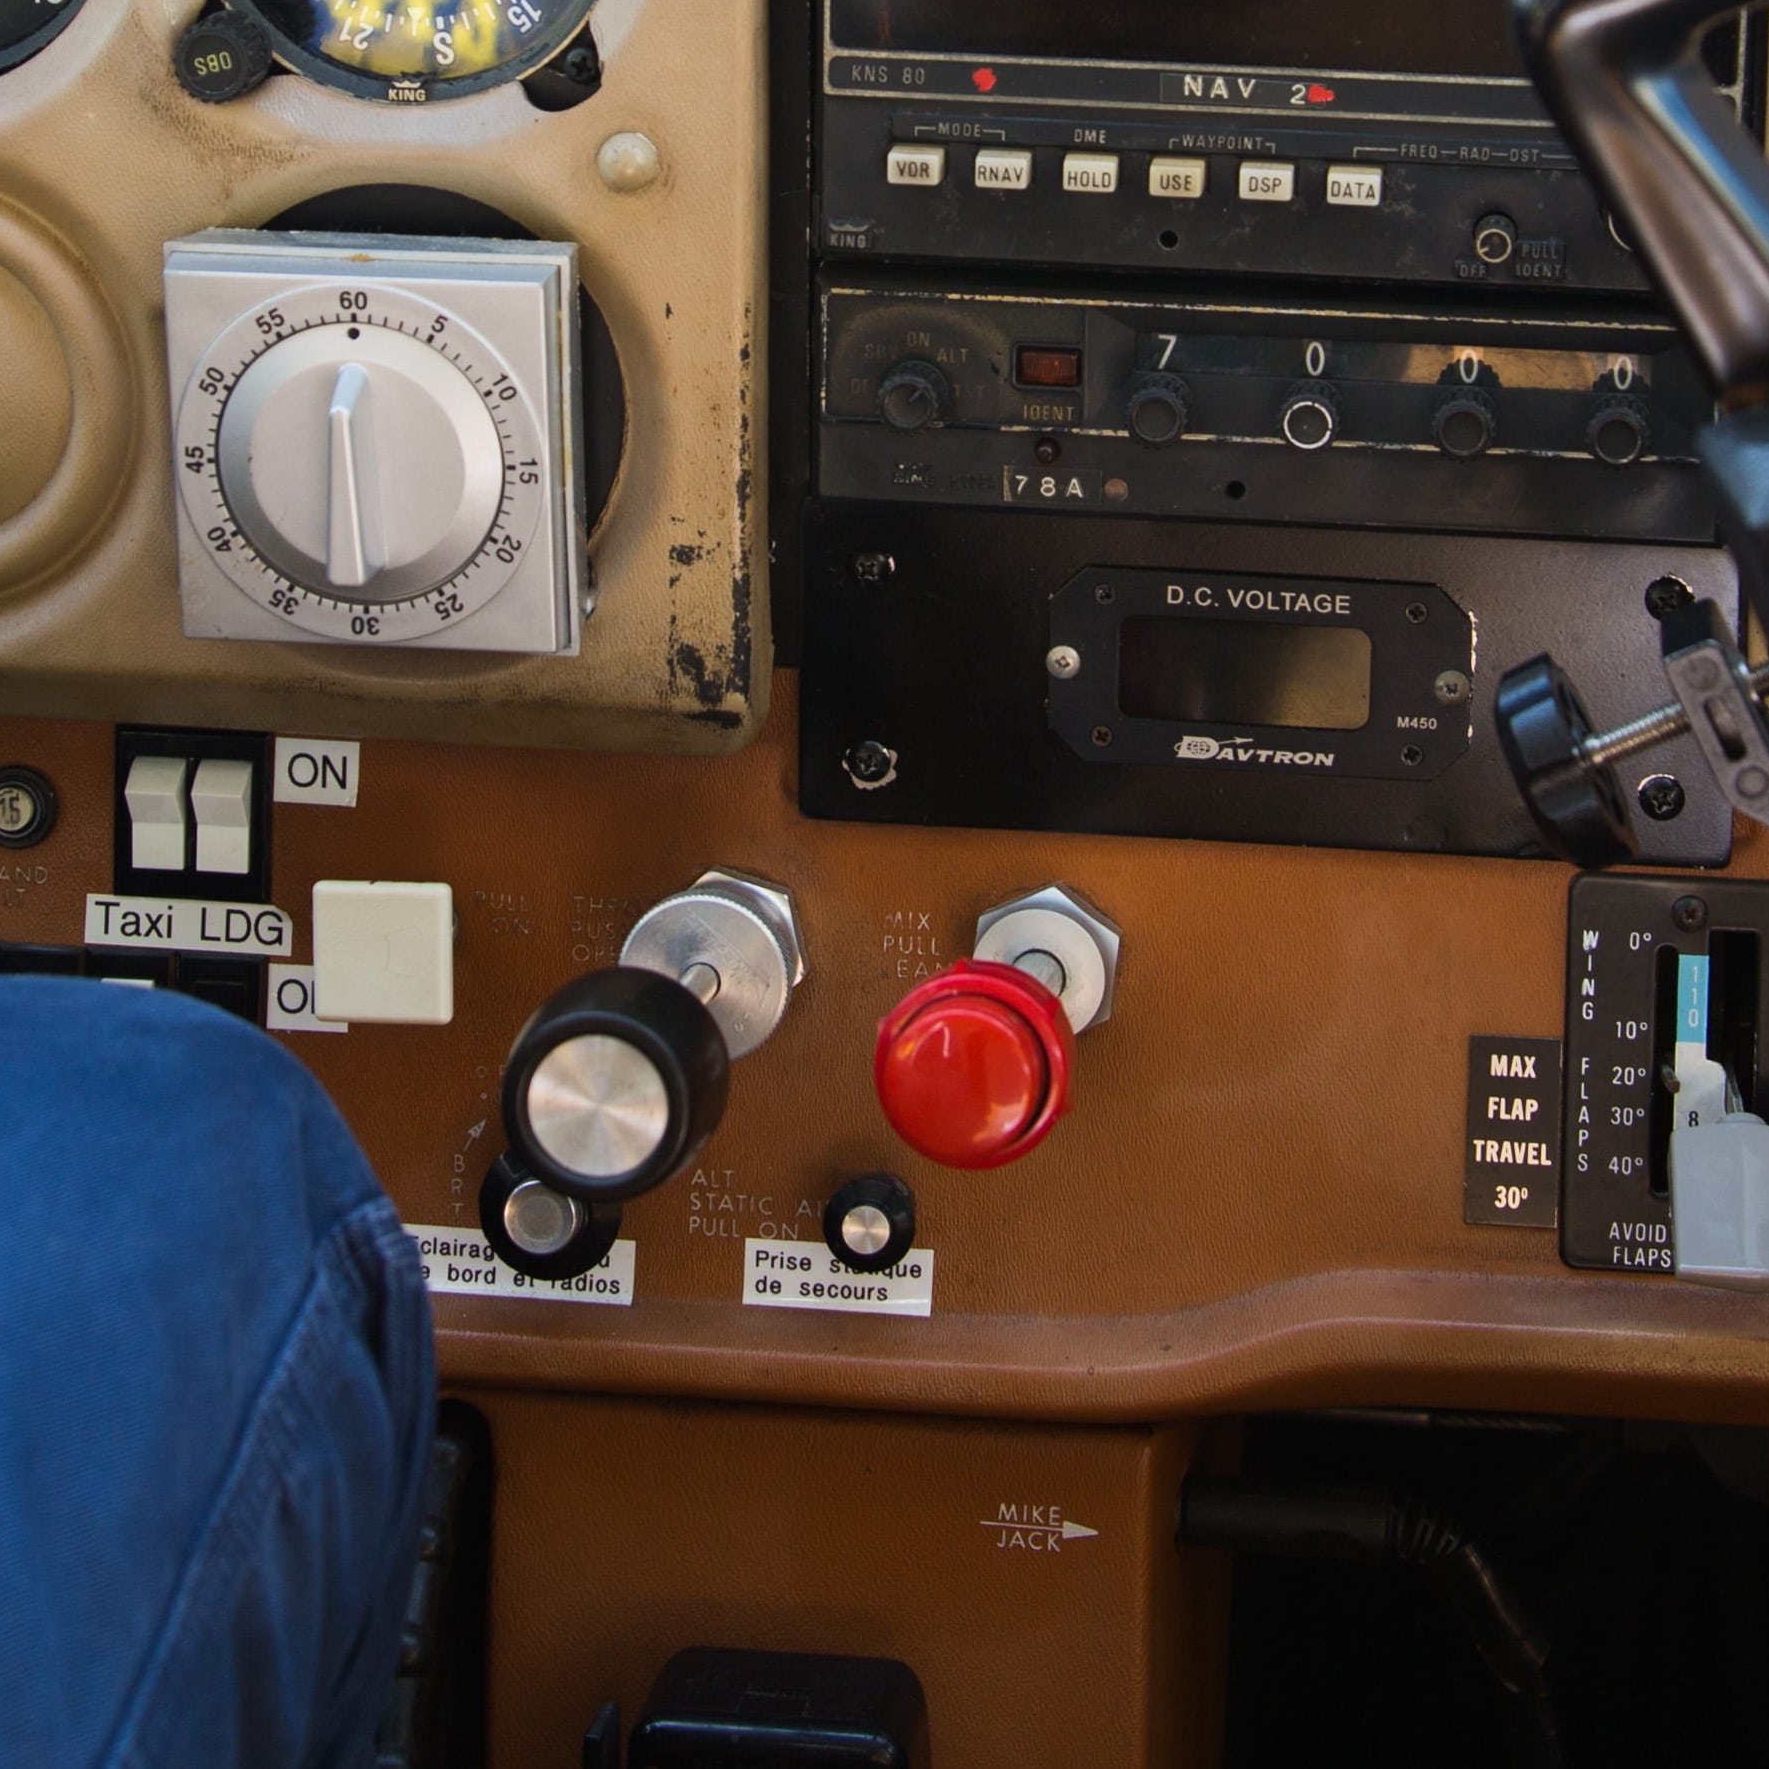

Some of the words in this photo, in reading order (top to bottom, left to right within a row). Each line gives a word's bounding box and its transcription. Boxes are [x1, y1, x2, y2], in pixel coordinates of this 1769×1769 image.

[388, 88, 425, 102] KING
[1184, 75, 1256, 99] NAV
[1289, 85, 1306, 105] 2
[1075, 129, 1106, 143] DME
[897, 162, 929, 178] VOR
[978, 165, 1022, 181] RNAV
[1067, 171, 1112, 188] HOLD
[1160, 174, 1192, 191] USE
[1248, 177, 1281, 193] DSP
[1331, 180, 1375, 199] DATA
[1167, 586, 1218, 607] D.C.
[1228, 589, 1351, 614] VOLTAGE
[288, 753, 347, 790] ON
[94, 901, 172, 938] Taxi
[201, 907, 283, 946] LDG
[1490, 1055, 1536, 1078] MAX
[1488, 1098, 1538, 1120] FLAP
[1473, 1140, 1552, 1166] TRAVEL
[1610, 1222, 1666, 1243] AVOID
[755, 1251, 812, 1272] Prise
[1614, 1247, 1672, 1268] FLAPS
[755, 1277, 781, 1296] de
[799, 1279, 888, 1302] secours
[998, 1503, 1061, 1525] MIKE
[997, 1531, 1061, 1551] JACK
